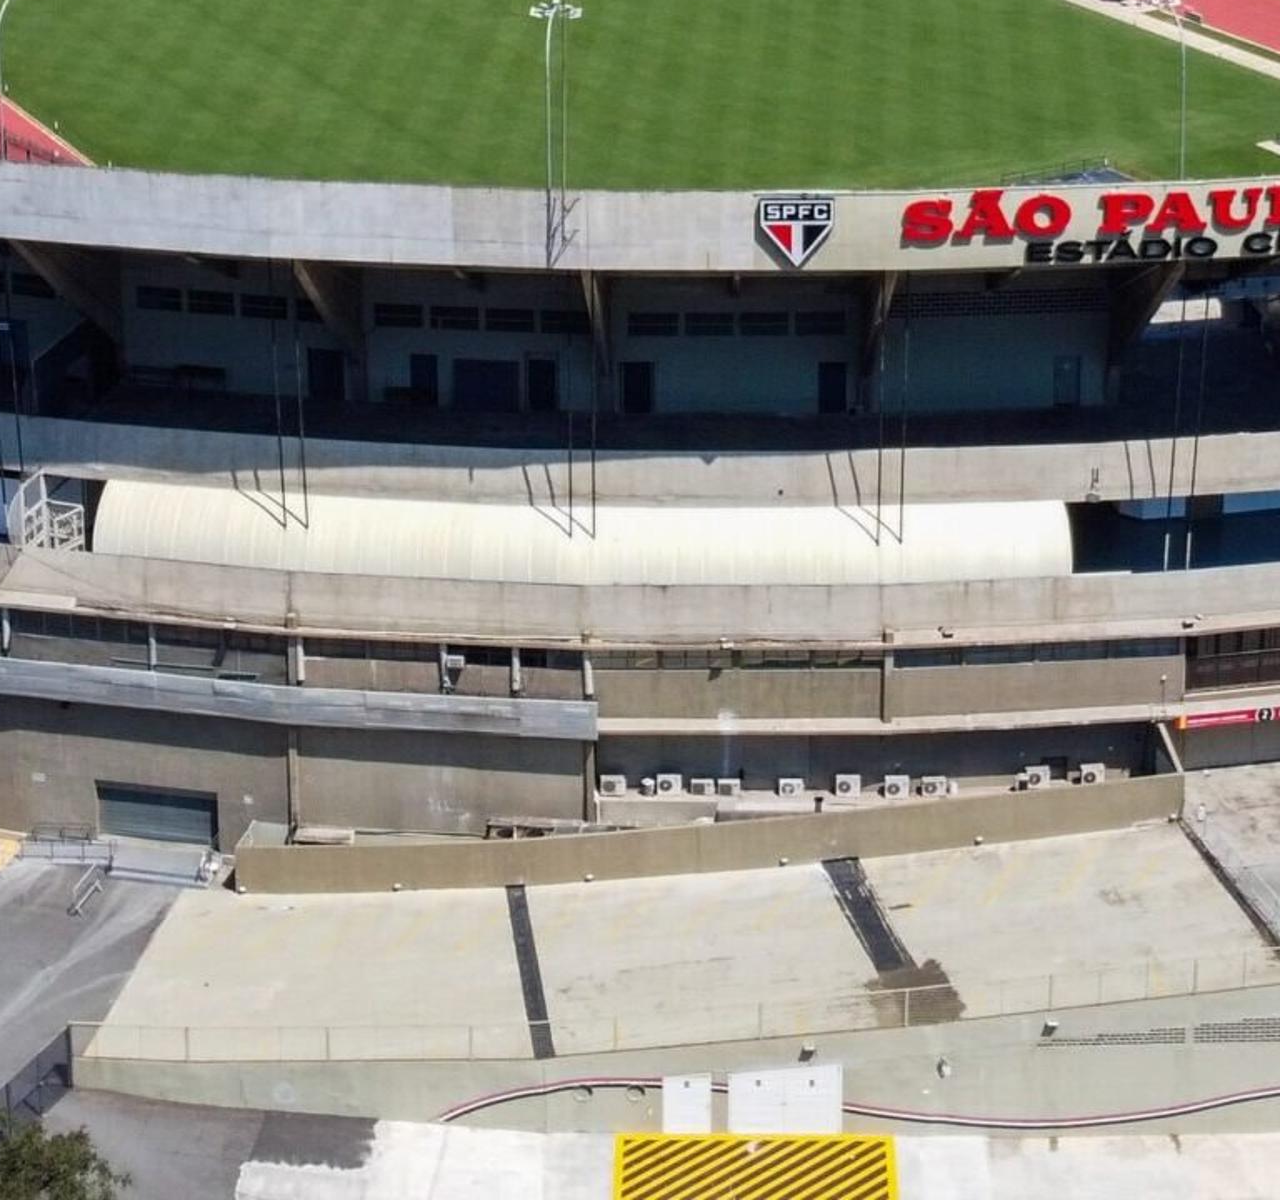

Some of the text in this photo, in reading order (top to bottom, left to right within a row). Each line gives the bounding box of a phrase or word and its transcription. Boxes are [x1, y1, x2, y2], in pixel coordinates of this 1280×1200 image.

[767, 205, 828, 220] SPFC
[904, 190, 1070, 240] SÃO
[1024, 230, 1218, 262] ESTÁDIO
